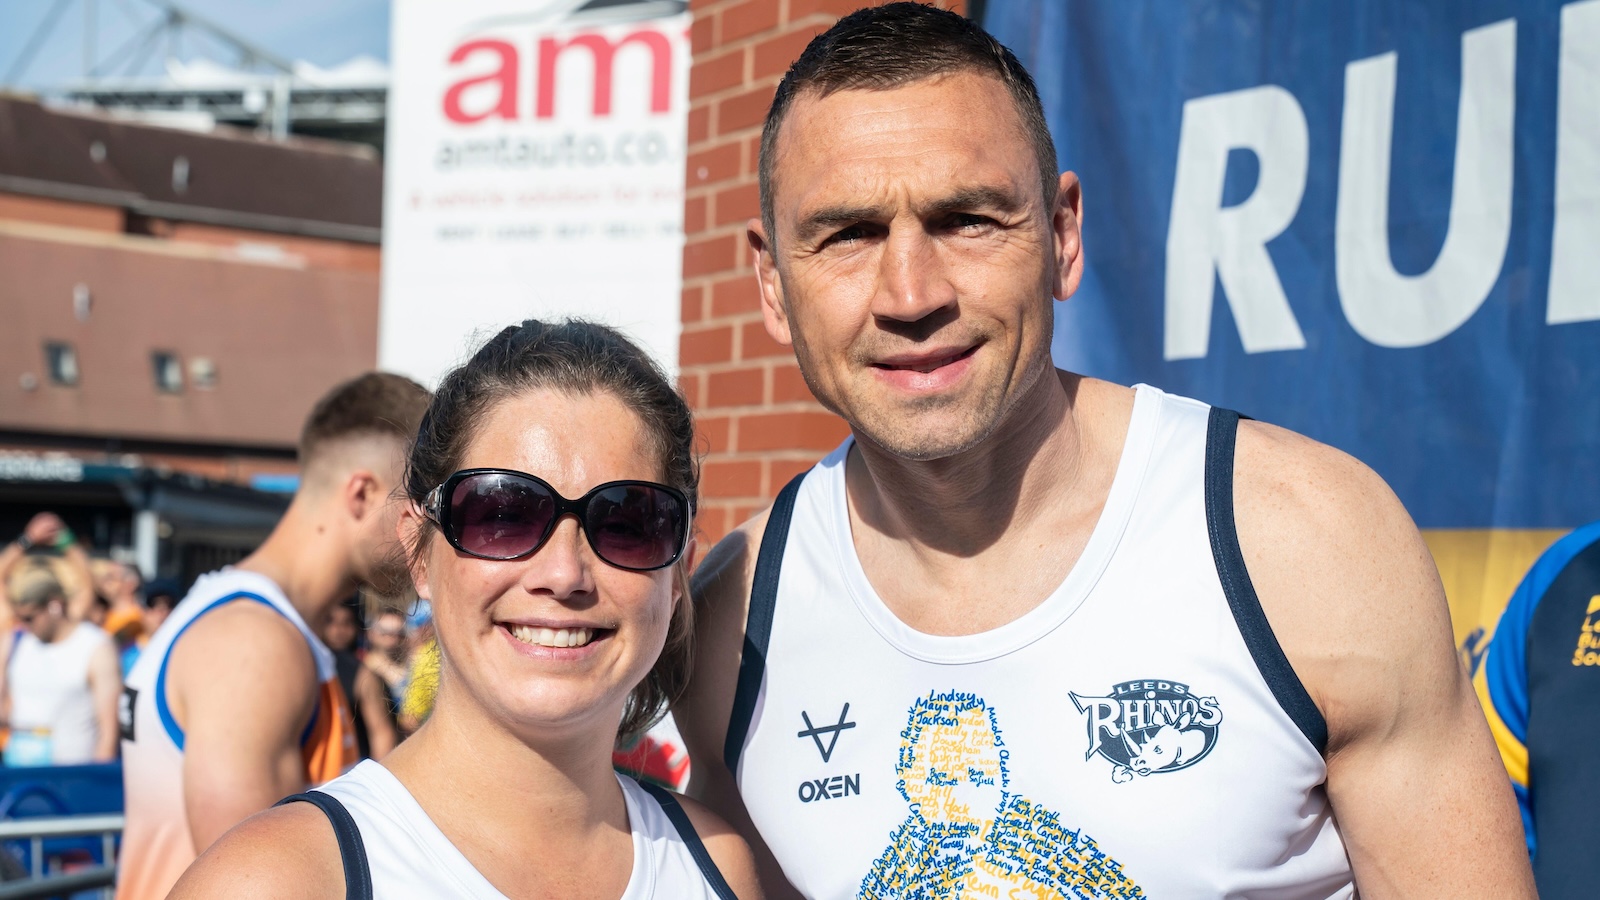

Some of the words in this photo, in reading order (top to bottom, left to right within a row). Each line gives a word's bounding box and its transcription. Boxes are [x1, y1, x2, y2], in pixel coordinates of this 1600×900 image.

[441, 28, 691, 126] am
[929, 688, 976, 703] Lindsey
[1116, 681, 1186, 695] LEEDS
[915, 697, 949, 716] Maya
[916, 710, 958, 726] Jackson
[798, 773, 860, 803] OXEN
